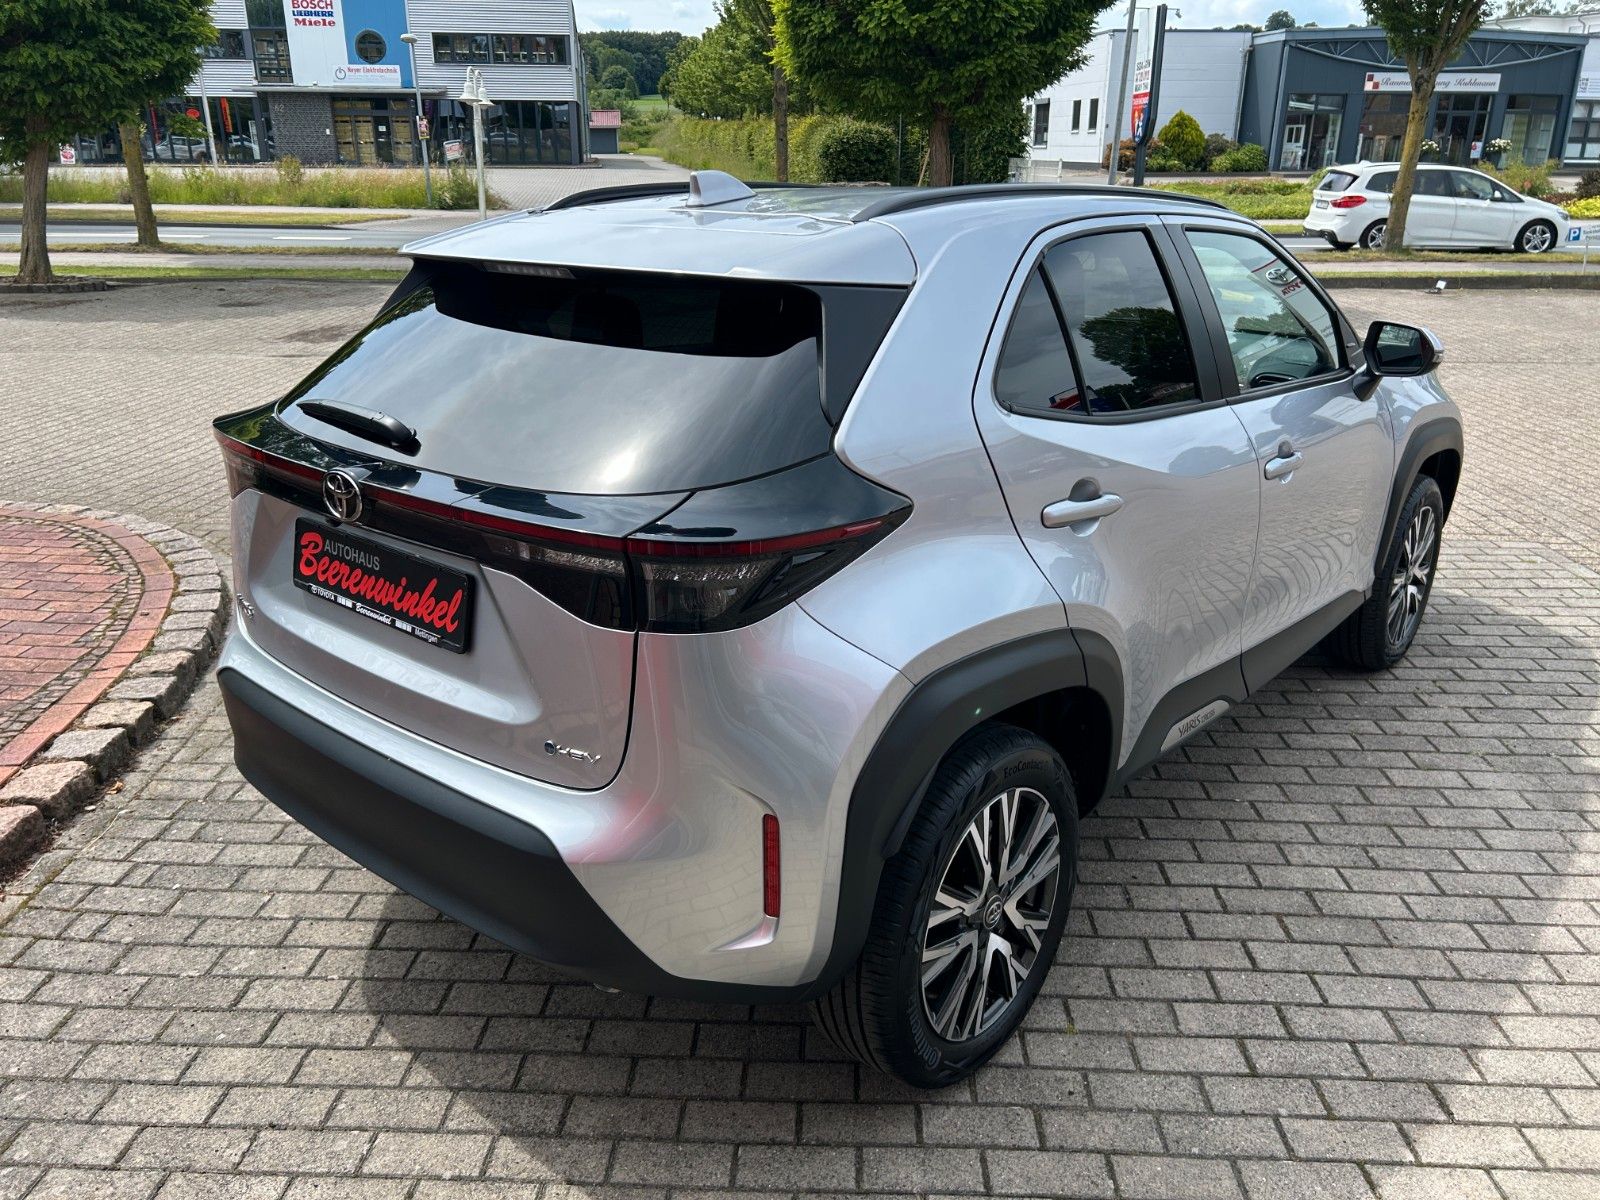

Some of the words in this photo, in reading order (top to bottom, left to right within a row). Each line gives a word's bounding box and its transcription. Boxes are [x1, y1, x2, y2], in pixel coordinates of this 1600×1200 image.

[291, 0, 334, 9] BOSCH
[294, 18, 336, 26] Miele
[324, 538, 380, 571] AUTOHAUS
[299, 531, 464, 633] Beerenwinkel
[317, 588, 335, 601] TOYOTA
[355, 602, 392, 625] Beerenwinkel
